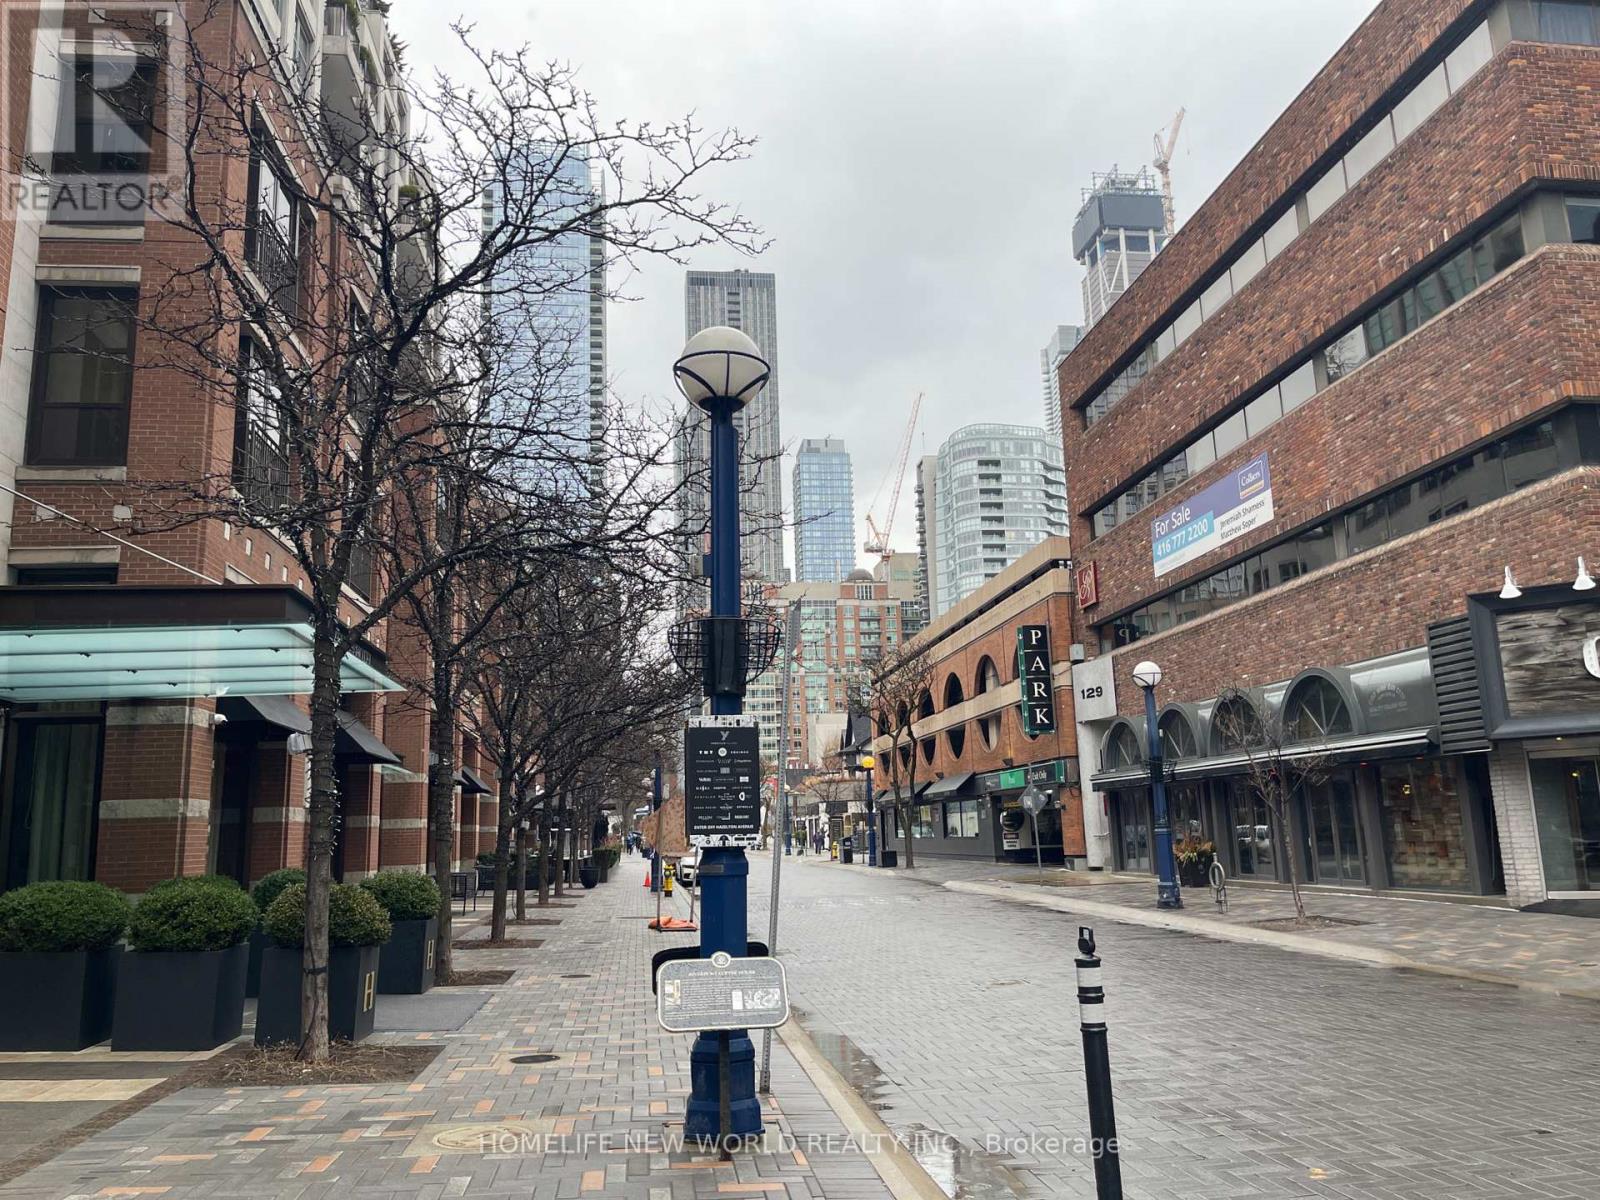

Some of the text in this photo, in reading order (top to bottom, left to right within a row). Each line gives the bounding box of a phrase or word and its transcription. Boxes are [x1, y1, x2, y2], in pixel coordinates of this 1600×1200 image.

[1155, 505, 1191, 538] For Sale
[1157, 518, 1208, 557] 416 777 2200
[1030, 629, 1050, 724] PARK
[1081, 686, 1103, 699] 129
[363, 971, 375, 1012] H
